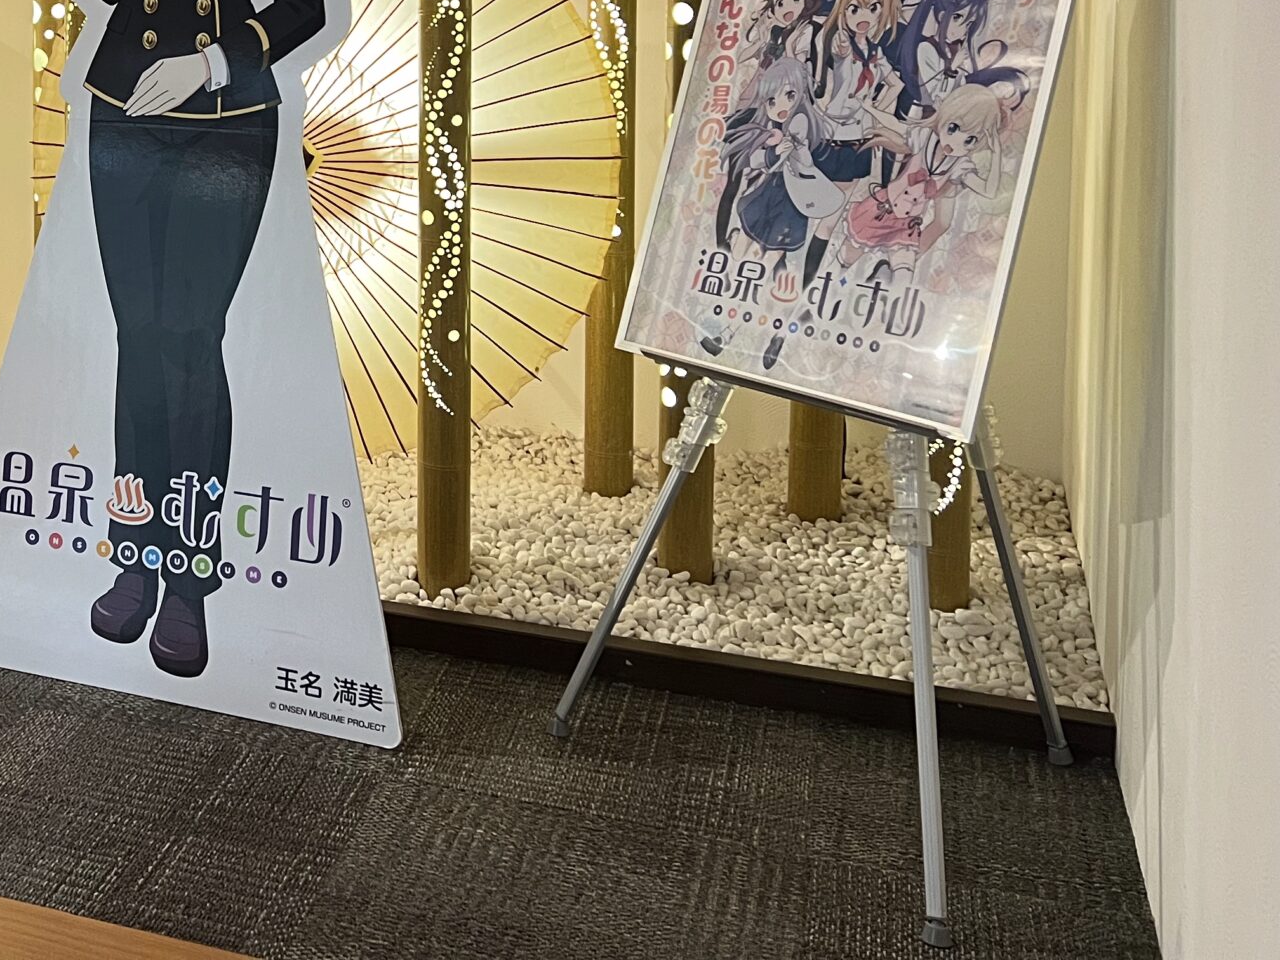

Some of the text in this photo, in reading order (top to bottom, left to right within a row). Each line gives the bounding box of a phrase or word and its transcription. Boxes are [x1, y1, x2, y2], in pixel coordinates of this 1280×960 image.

[275, 666, 383, 712] 玉名 満美
[278, 703, 307, 716] ONSEN
[308, 709, 345, 724] MUSUME
[347, 717, 386, 733] PROJECT
